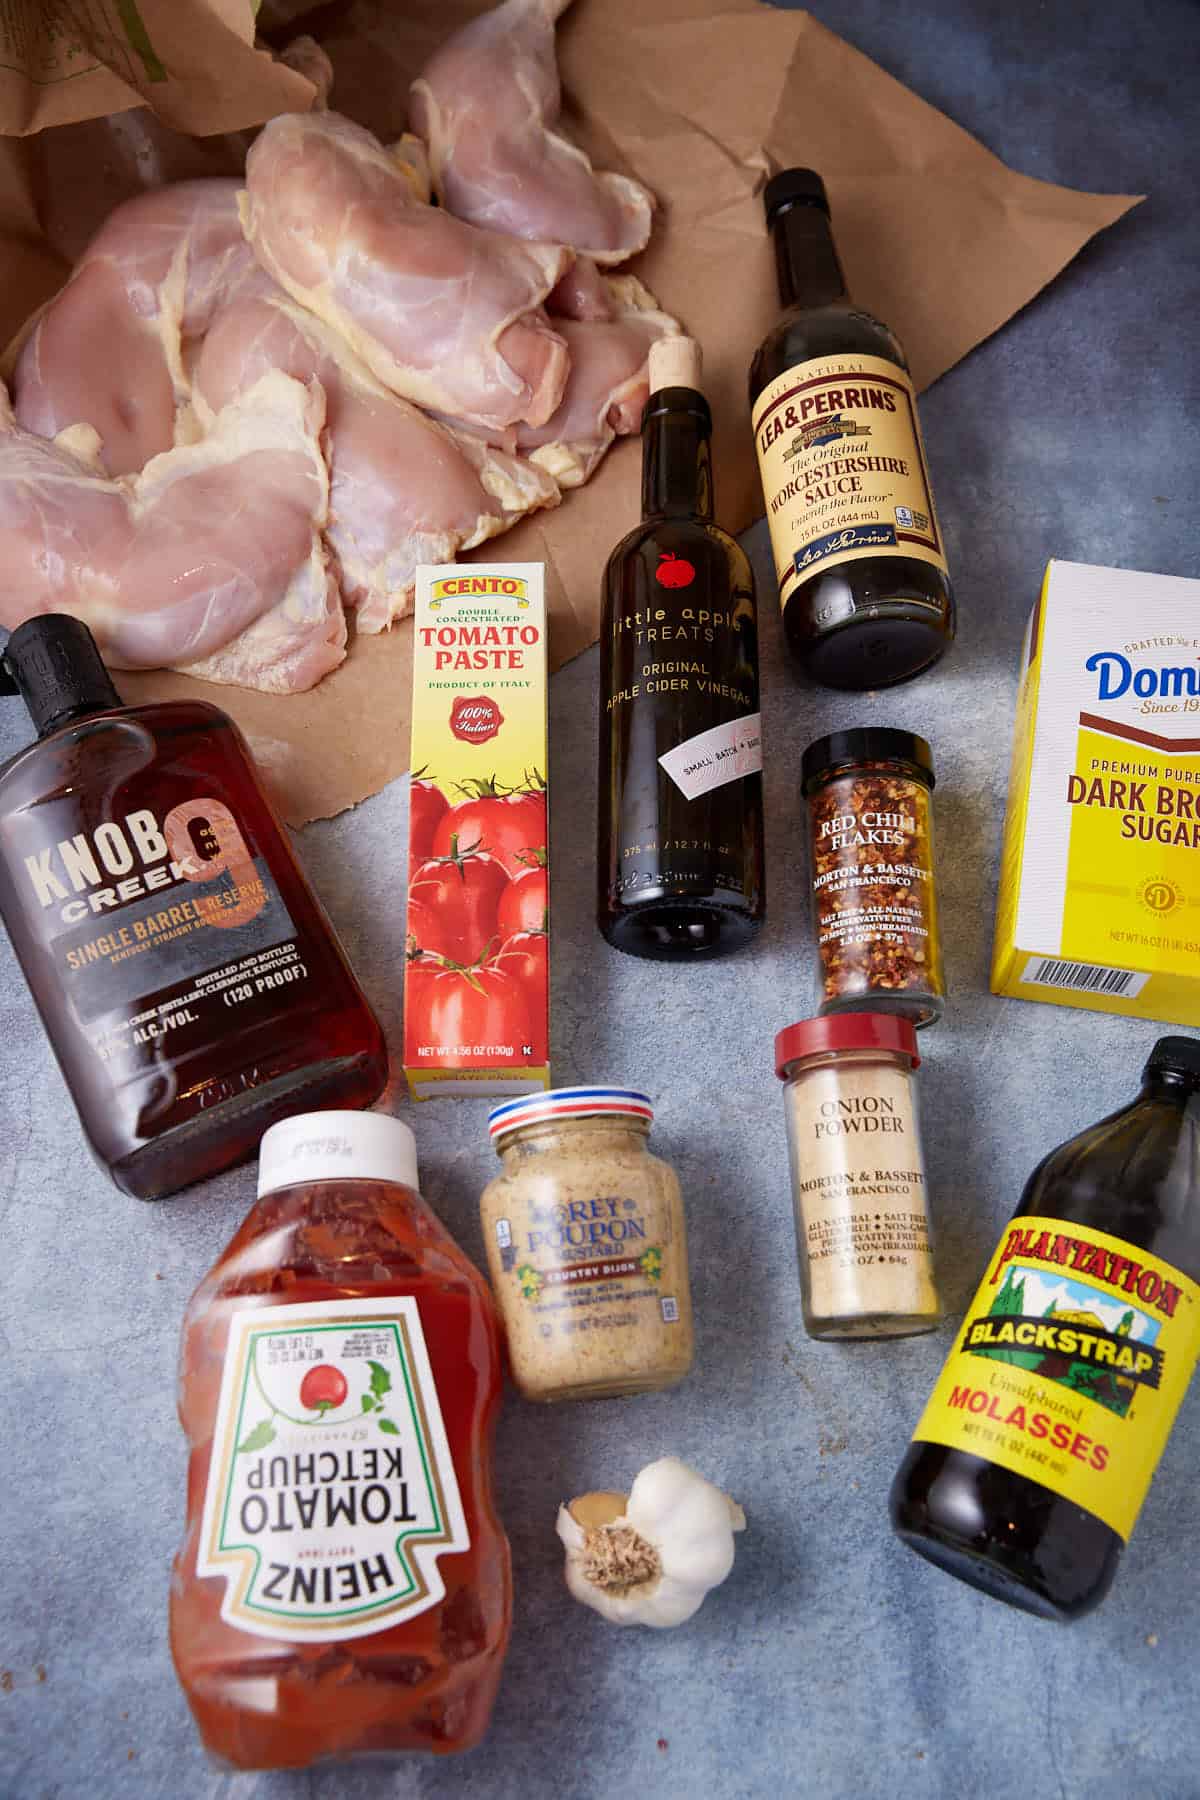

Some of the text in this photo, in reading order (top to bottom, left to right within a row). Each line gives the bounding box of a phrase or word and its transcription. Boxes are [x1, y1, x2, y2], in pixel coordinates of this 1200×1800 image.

[796, 363, 865, 382] NATURAL
[791, 441, 869, 475] The Original
[770, 457, 910, 515] WORCESTERSHIRE
[805, 476, 863, 507] SAUCE
[441, 578, 519, 595] CENTO
[458, 608, 500, 616] DOUBLE
[612, 607, 666, 639] little
[420, 625, 540, 647] TOMATO
[635, 626, 715, 646] TREATS
[1124, 637, 1173, 653] CRAFTED
[435, 650, 525, 671] PASTE
[642, 661, 711, 677] ORIGINAL
[428, 680, 531, 689] PRODUCT OF ITALY
[1086, 652, 1200, 701] Dom
[606, 685, 640, 713] APPLE
[646, 679, 690, 694] CIDER
[458, 706, 494, 720] 100%
[455, 720, 496, 733] Italian
[683, 758, 713, 775] SMALL
[1090, 759, 1159, 777] PREMIUM
[1067, 774, 1148, 812] DARK
[820, 814, 857, 838] RED
[831, 829, 906, 851] FLAKES
[23, 808, 169, 908] KNOB
[812, 865, 859, 891] MORTON
[862, 864, 875, 875] &
[828, 876, 912, 892] SAN FRANCISCO
[60, 856, 200, 923] CREEK
[866, 905, 885, 915] ALL
[66, 878, 265, 970] SINGLE BARREL RESERVE
[152, 924, 194, 946] STRAIGHT
[194, 943, 296, 989] DISTILLED AND BOTTLED
[222, 983, 254, 1008] (120
[255, 963, 308, 994] PROOF)
[417, 1047, 434, 1057] NET
[473, 1045, 486, 1056] OZ
[820, 1096, 894, 1117] ONION
[814, 1115, 905, 1139] POWDER
[859, 1171, 871, 1182] &
[883, 1212, 907, 1222] SALT
[526, 1216, 647, 1253] POUPON
[857, 1255, 875, 1266] OZ
[989, 1229, 1184, 1318] PLANTATION
[968, 1321, 1154, 1376] BLACKSTRAP
[947, 1384, 1111, 1473] MOLASSES
[247, 1447, 404, 1490] KETCHUP
[240, 1482, 418, 1535] TOMATO
[261, 1553, 396, 1605] HEINZ
